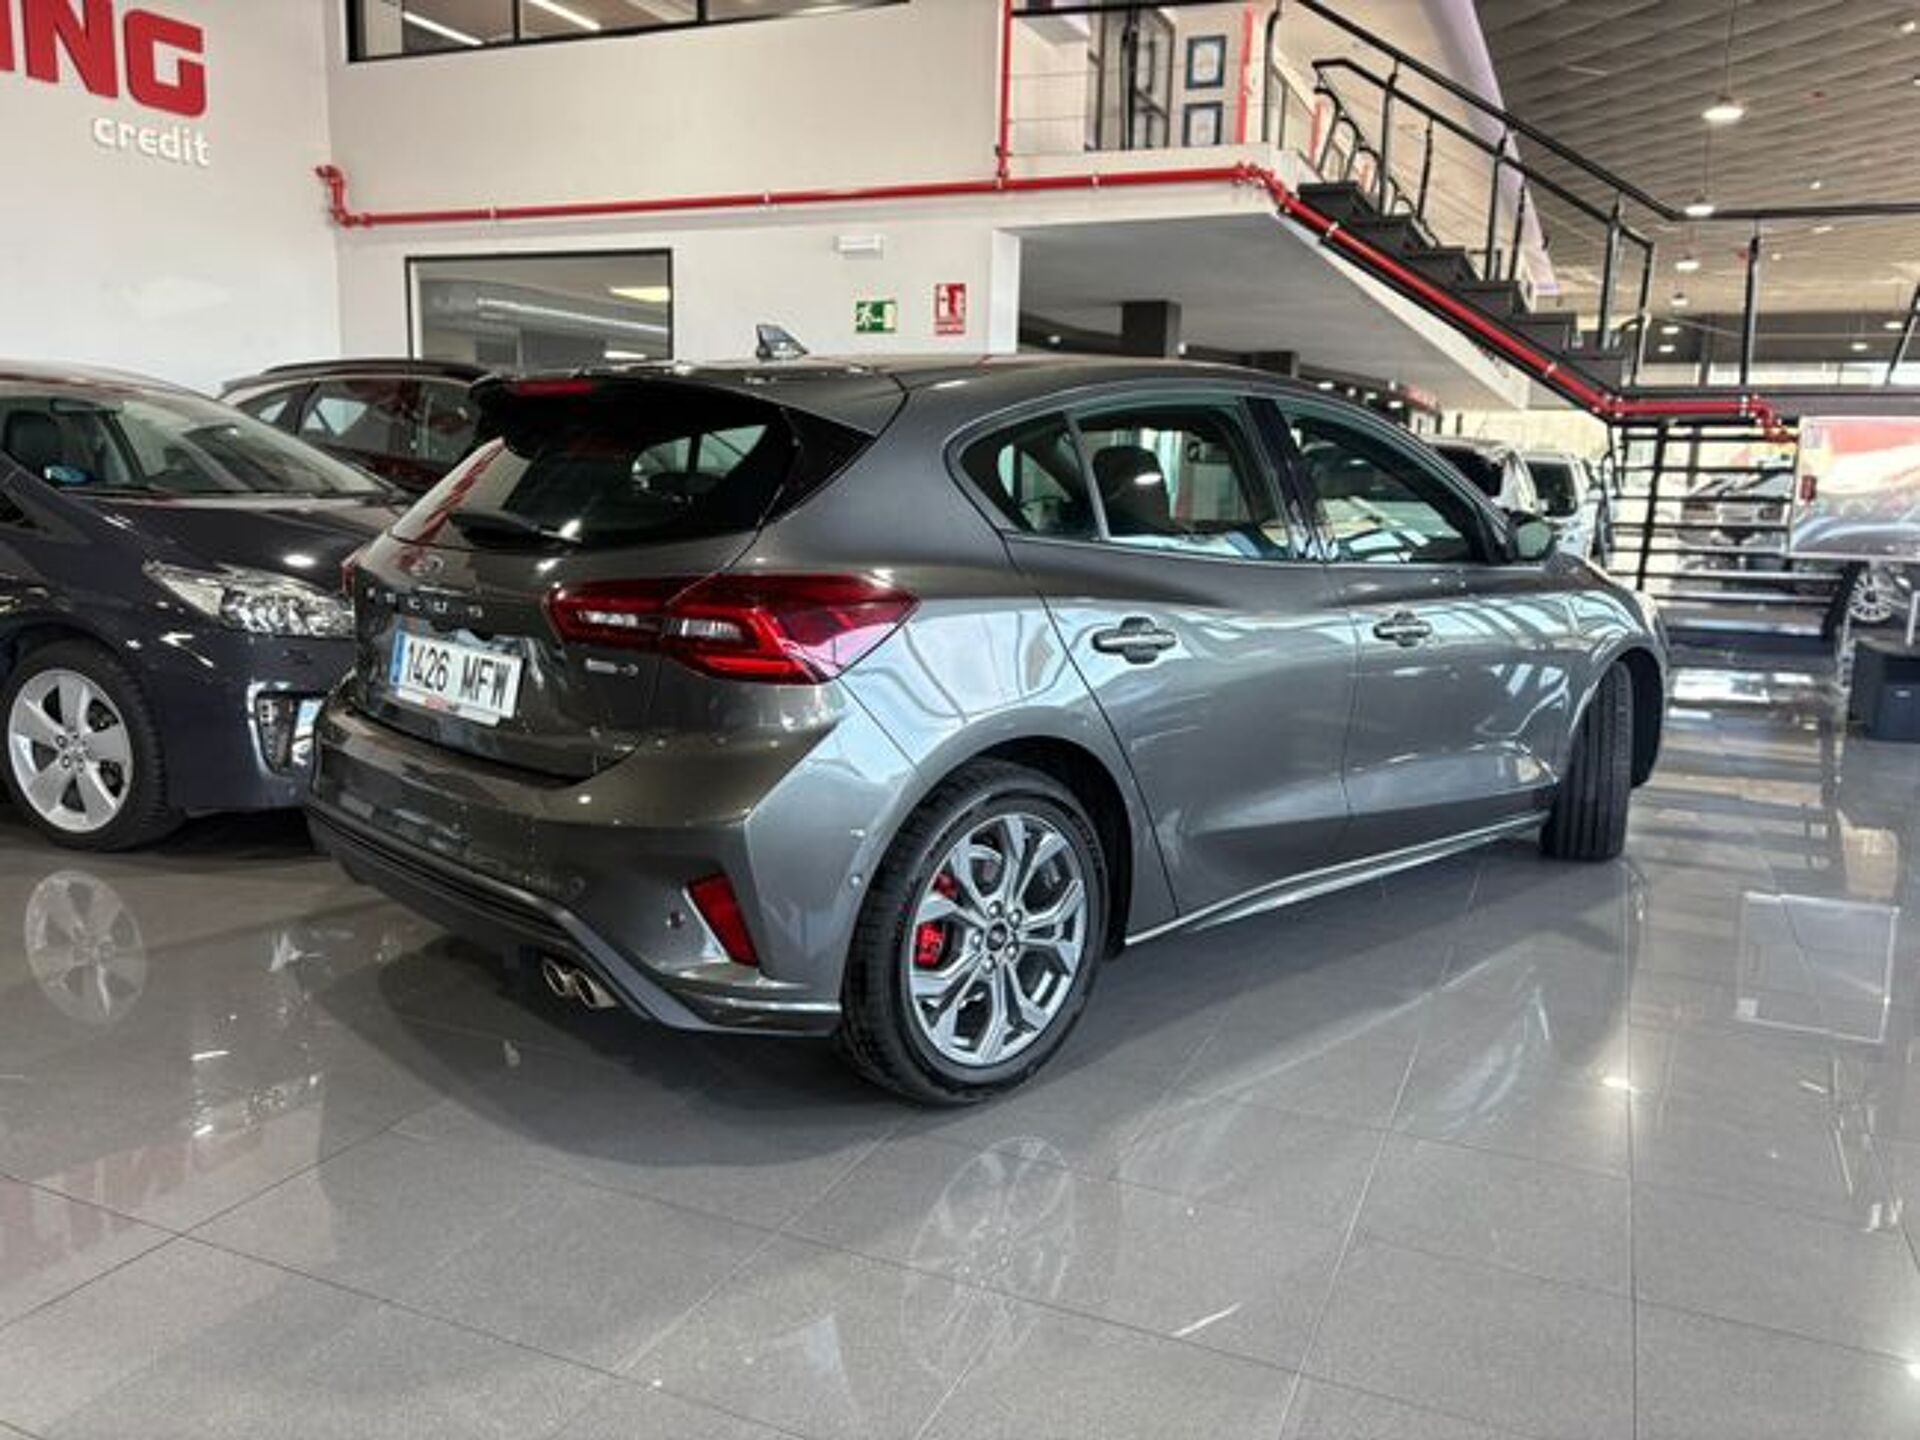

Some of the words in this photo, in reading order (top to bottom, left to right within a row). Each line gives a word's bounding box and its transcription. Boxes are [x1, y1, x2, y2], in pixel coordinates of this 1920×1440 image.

[93, 117, 210, 166] credit
[407, 642, 449, 691] 1426
[460, 656, 511, 709] MFW
